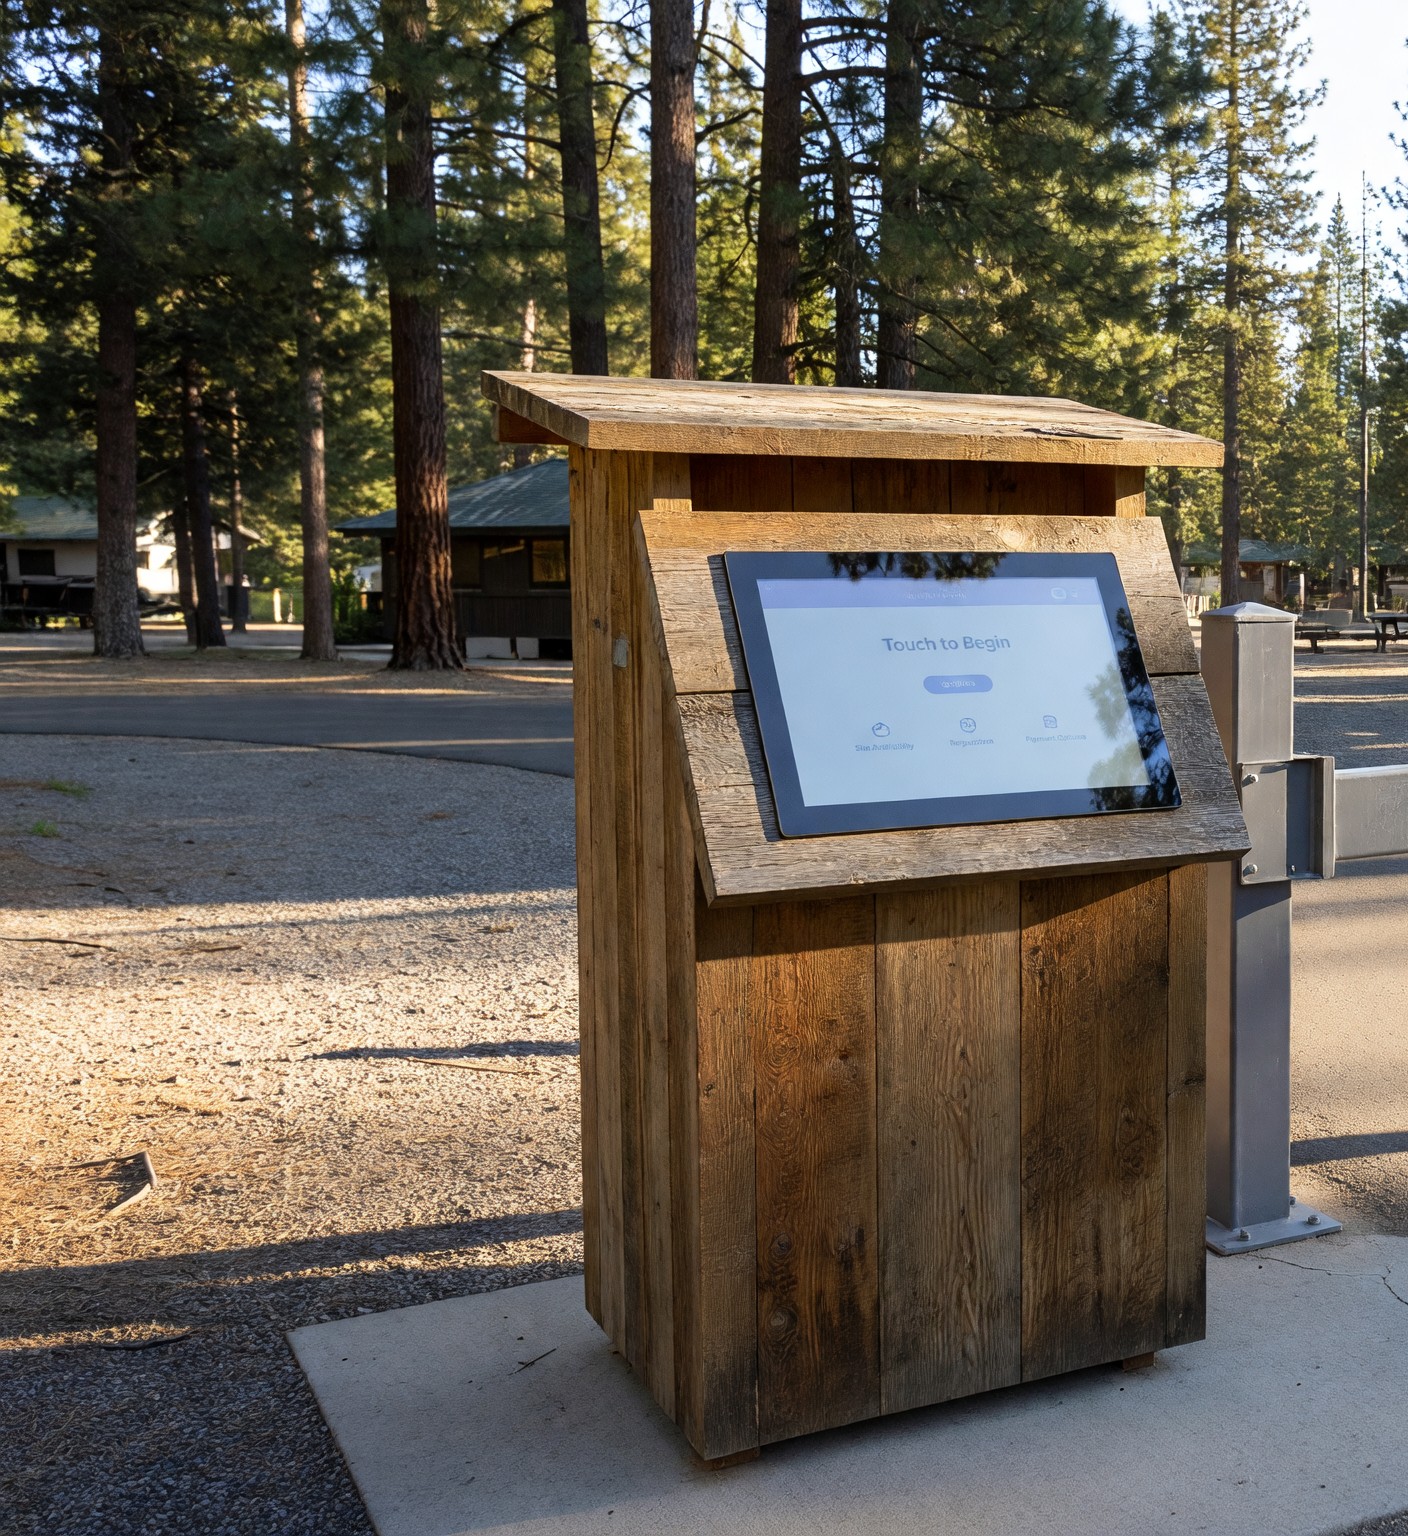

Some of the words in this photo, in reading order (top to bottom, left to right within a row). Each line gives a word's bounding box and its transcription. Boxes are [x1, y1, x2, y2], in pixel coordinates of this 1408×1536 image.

[882, 637, 937, 652] Touch
[940, 637, 959, 650] to
[963, 635, 1011, 652] Begin
